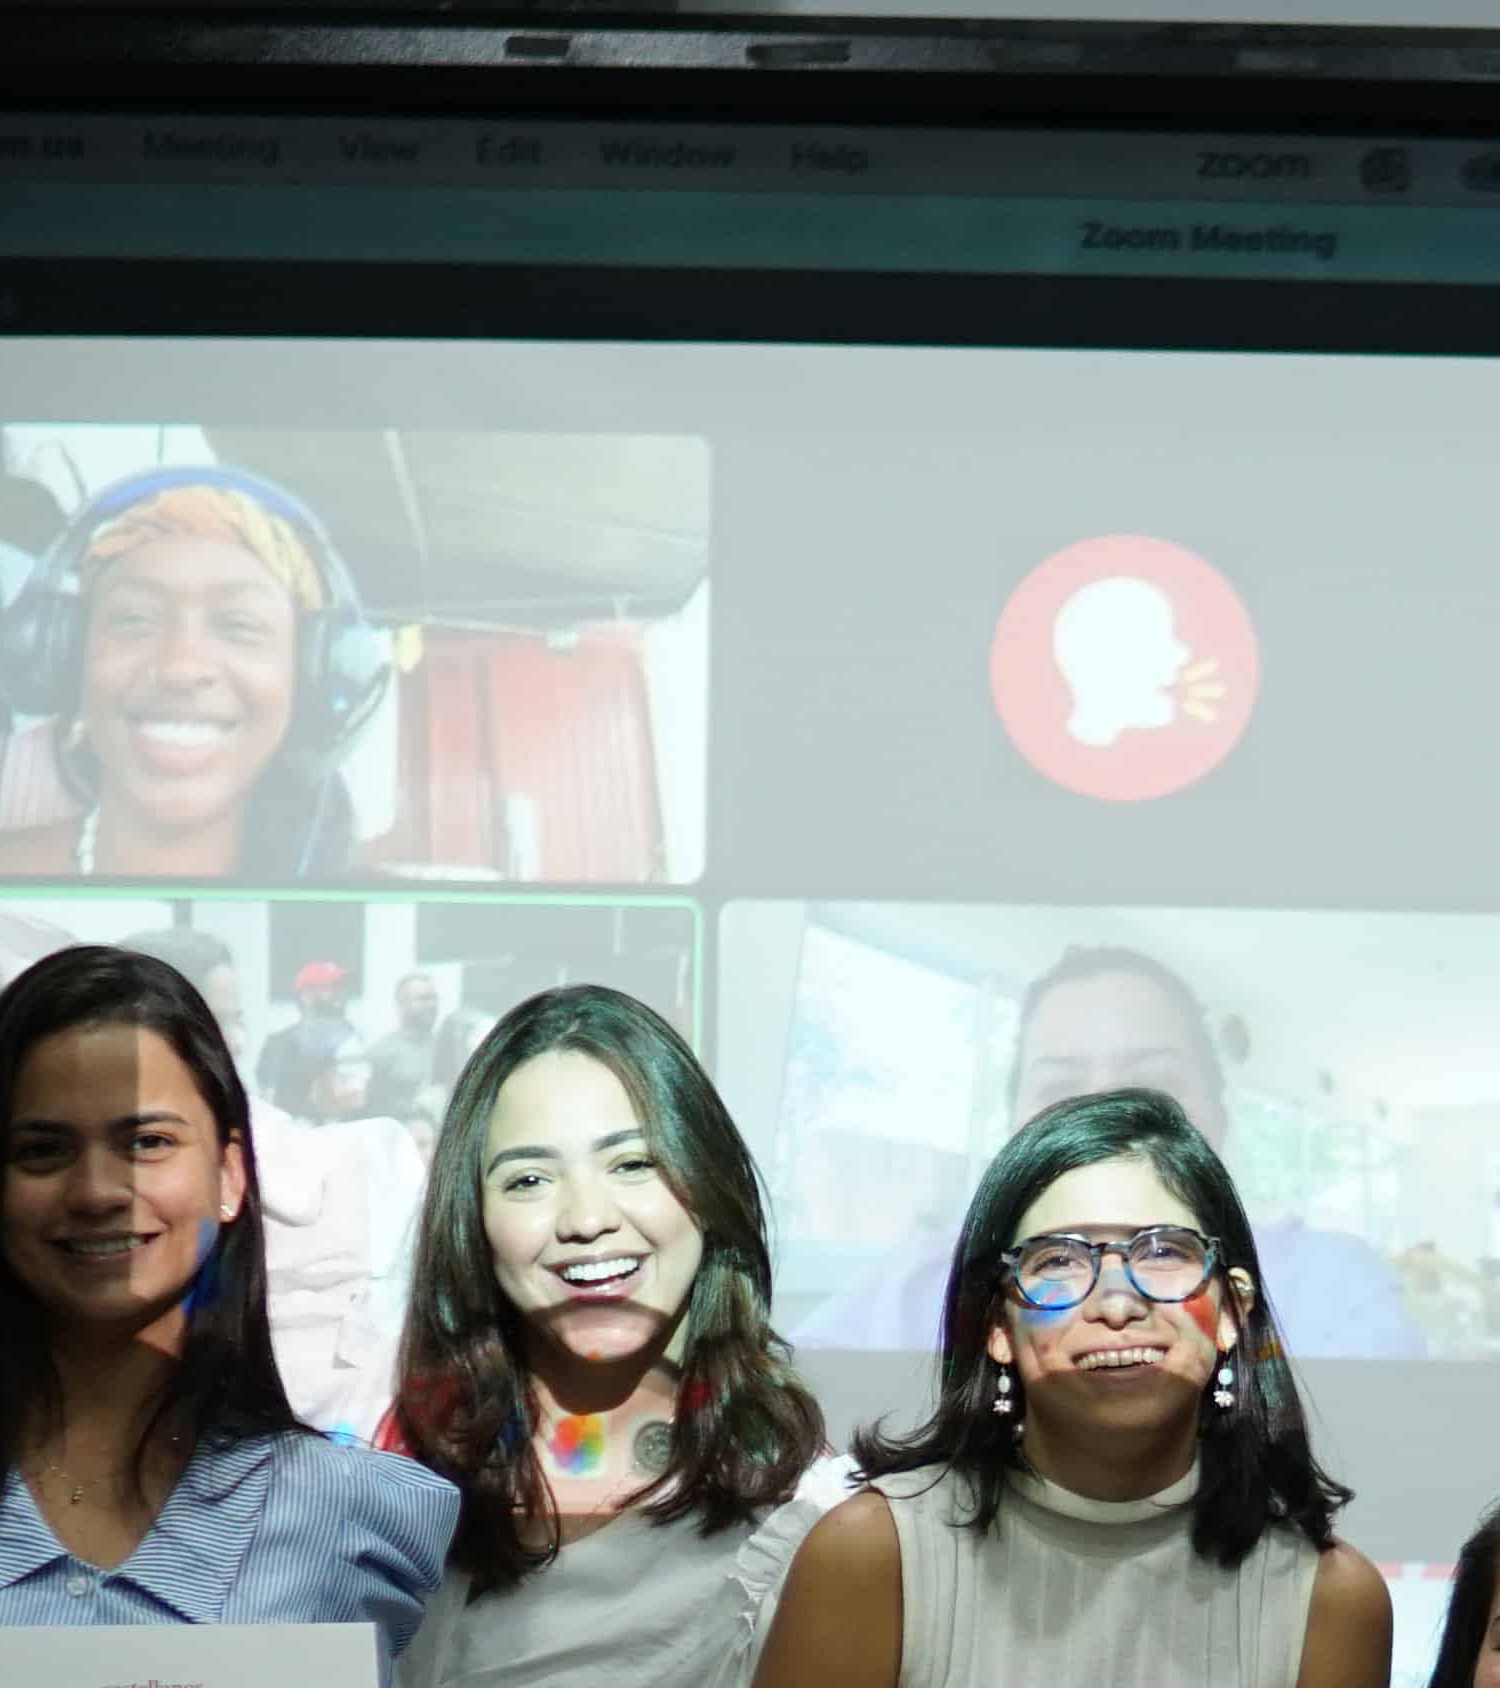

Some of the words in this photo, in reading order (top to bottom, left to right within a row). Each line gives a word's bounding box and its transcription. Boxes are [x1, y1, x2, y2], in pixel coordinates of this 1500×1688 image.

[143, 130, 281, 168] Meeting
[338, 133, 420, 163] View
[476, 136, 542, 165] Edit
[599, 136, 737, 168] Window
[790, 141, 868, 174] Help
[1080, 220, 1180, 253] Zoom
[1190, 222, 1338, 261] Meeting
